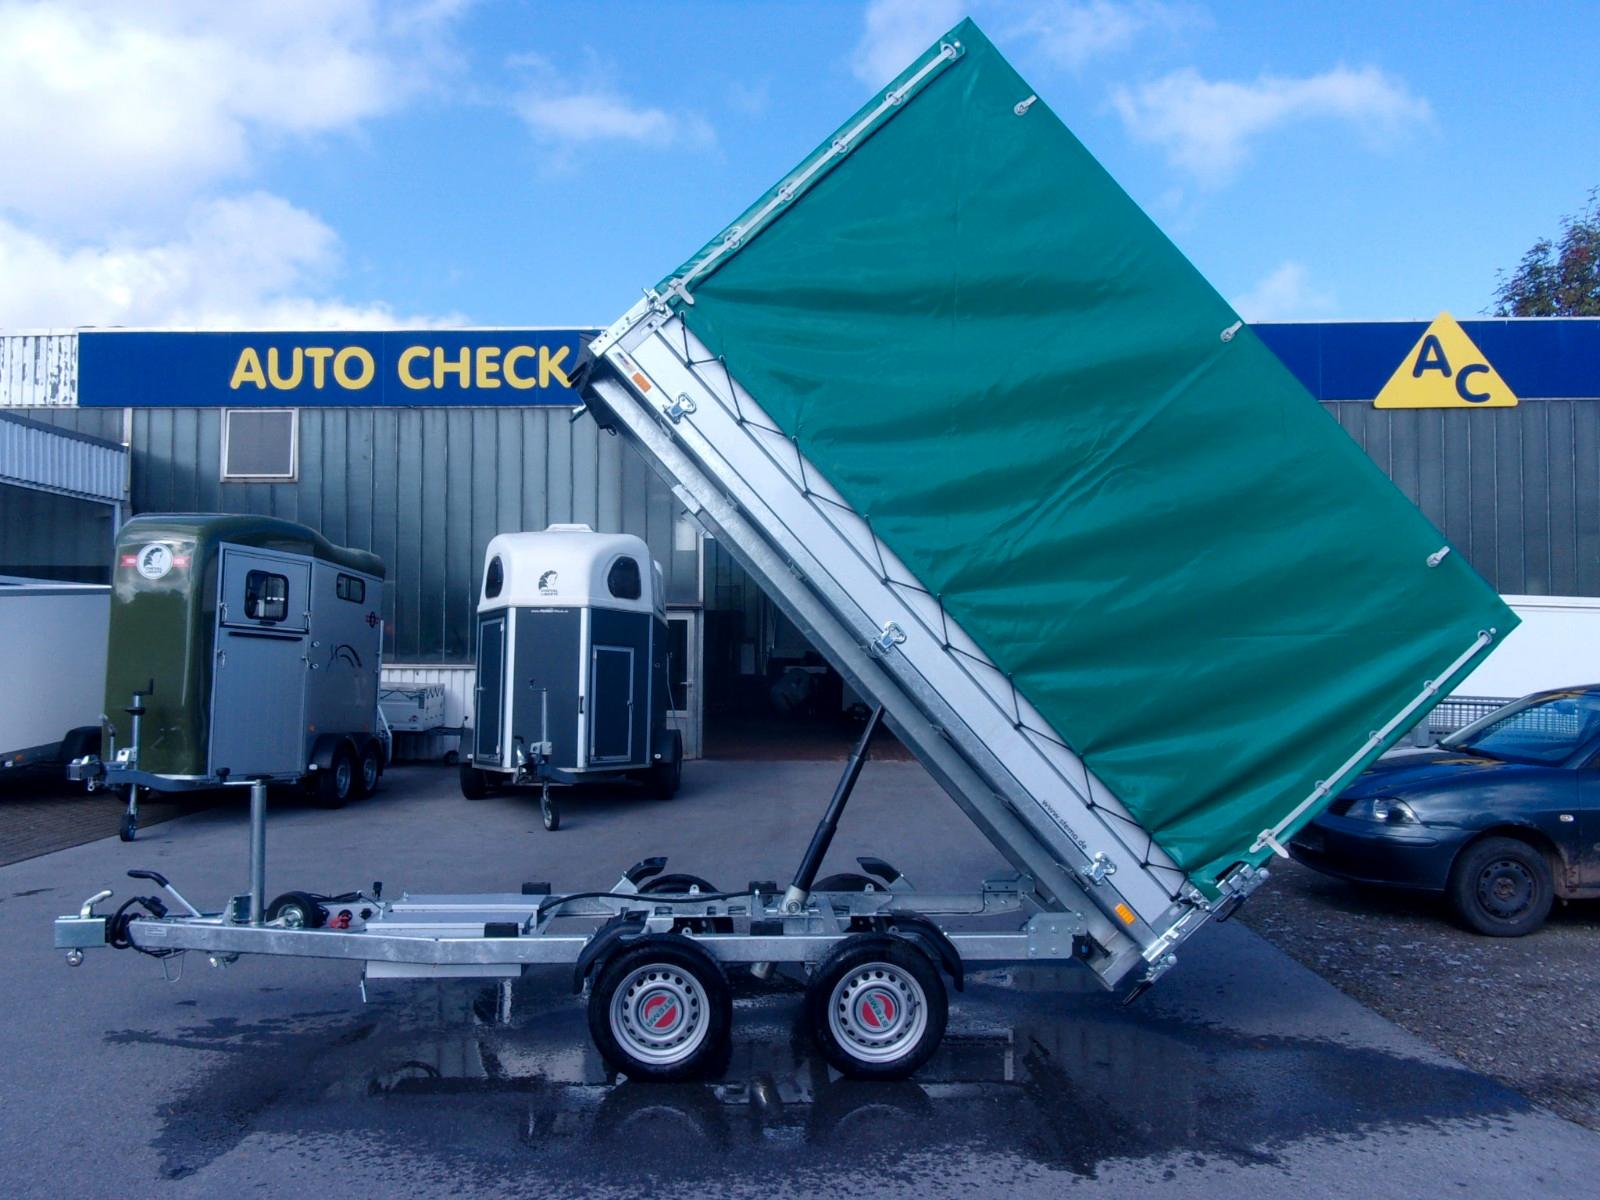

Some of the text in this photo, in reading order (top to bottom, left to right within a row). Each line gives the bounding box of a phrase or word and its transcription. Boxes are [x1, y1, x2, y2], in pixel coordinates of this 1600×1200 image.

[230, 345, 571, 391] AUTO CHECK
[1041, 799, 1088, 850] www.stema.de
